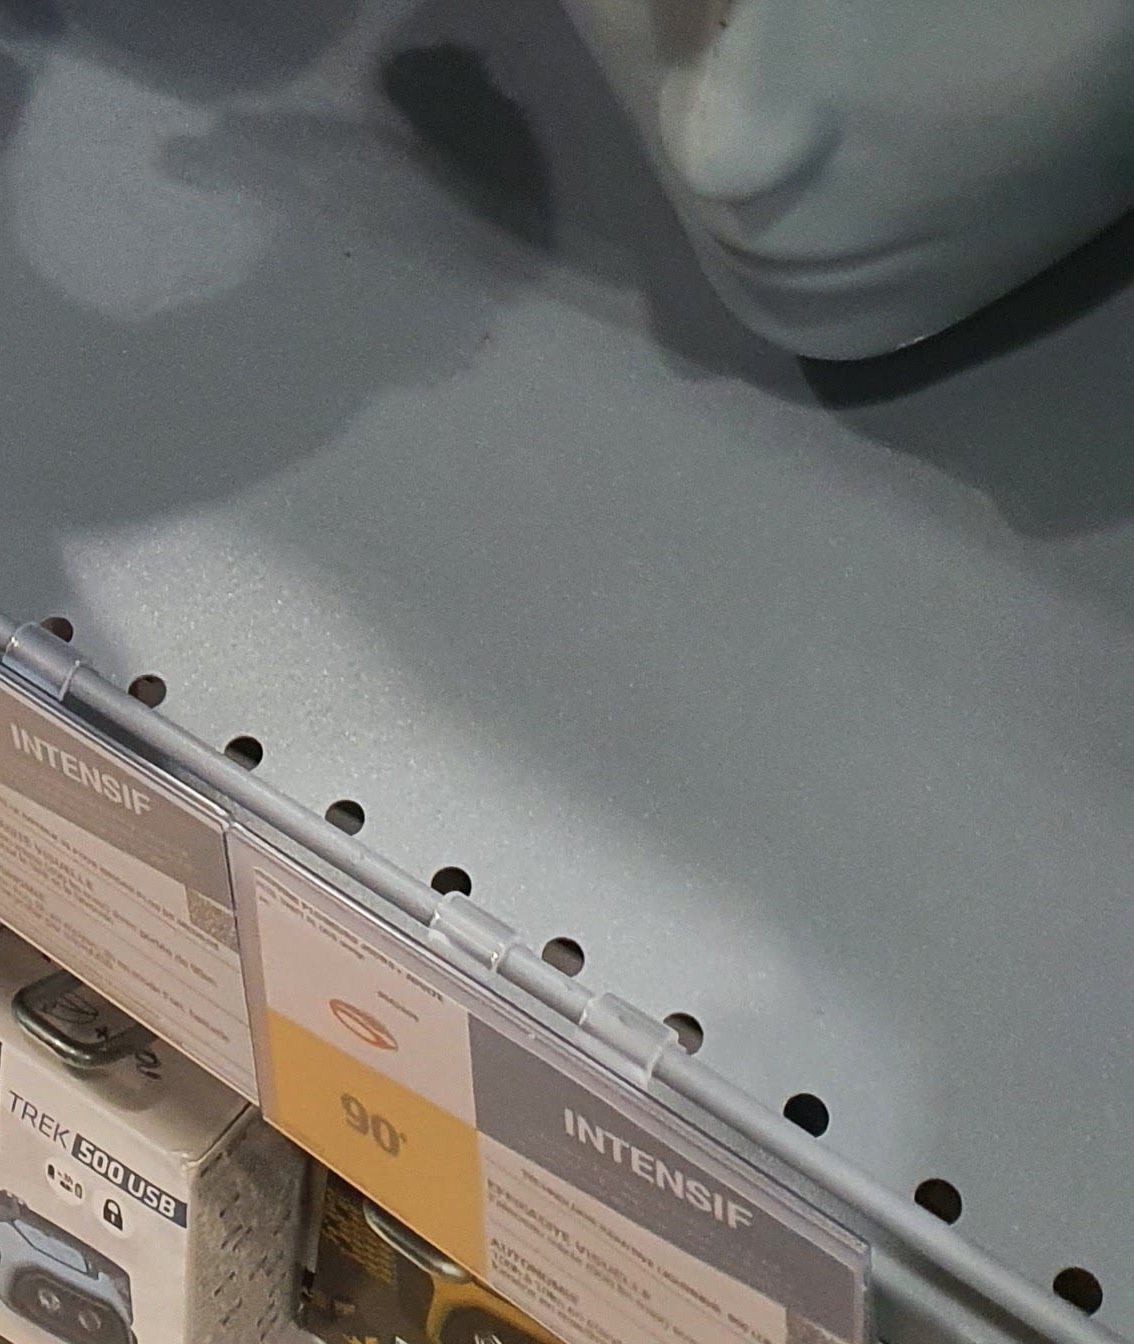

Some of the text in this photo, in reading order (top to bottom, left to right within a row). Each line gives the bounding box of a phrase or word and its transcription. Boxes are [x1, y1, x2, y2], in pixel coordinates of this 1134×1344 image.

[10, 722, 152, 816] INTENSIF
[9, 1089, 177, 1220] TREK 500 USB
[563, 1107, 754, 1230] INTENSIF
